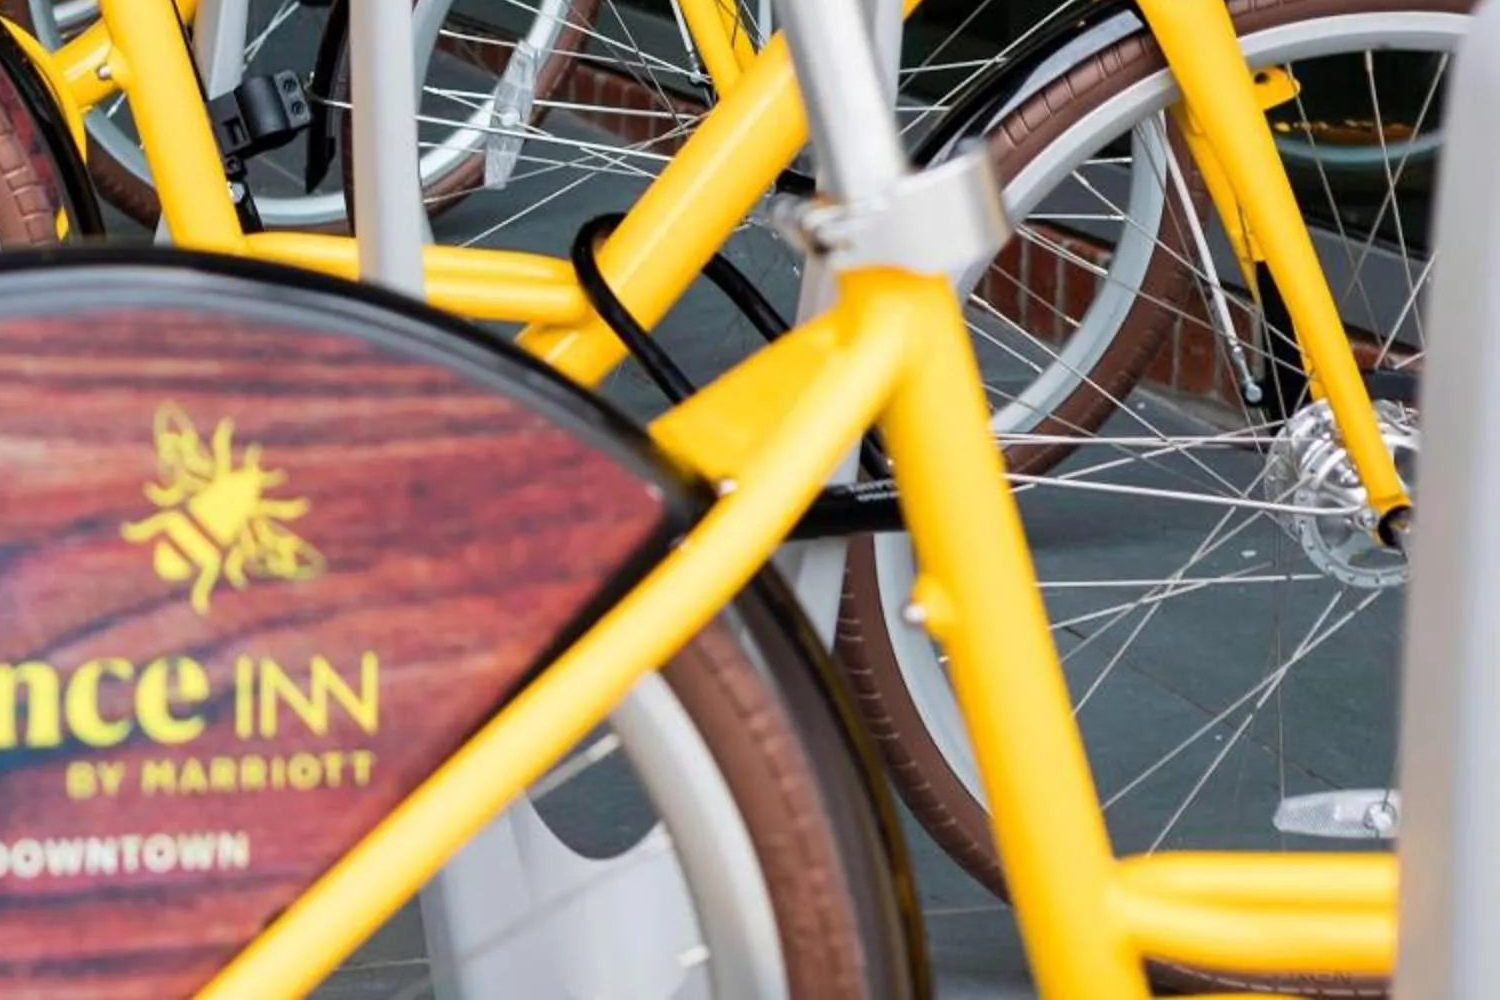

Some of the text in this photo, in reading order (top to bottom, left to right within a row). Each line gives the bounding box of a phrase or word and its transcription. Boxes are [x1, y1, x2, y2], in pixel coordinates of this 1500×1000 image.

[233, 650, 380, 740] INN
[66, 750, 376, 799] BY MARRIOTT
